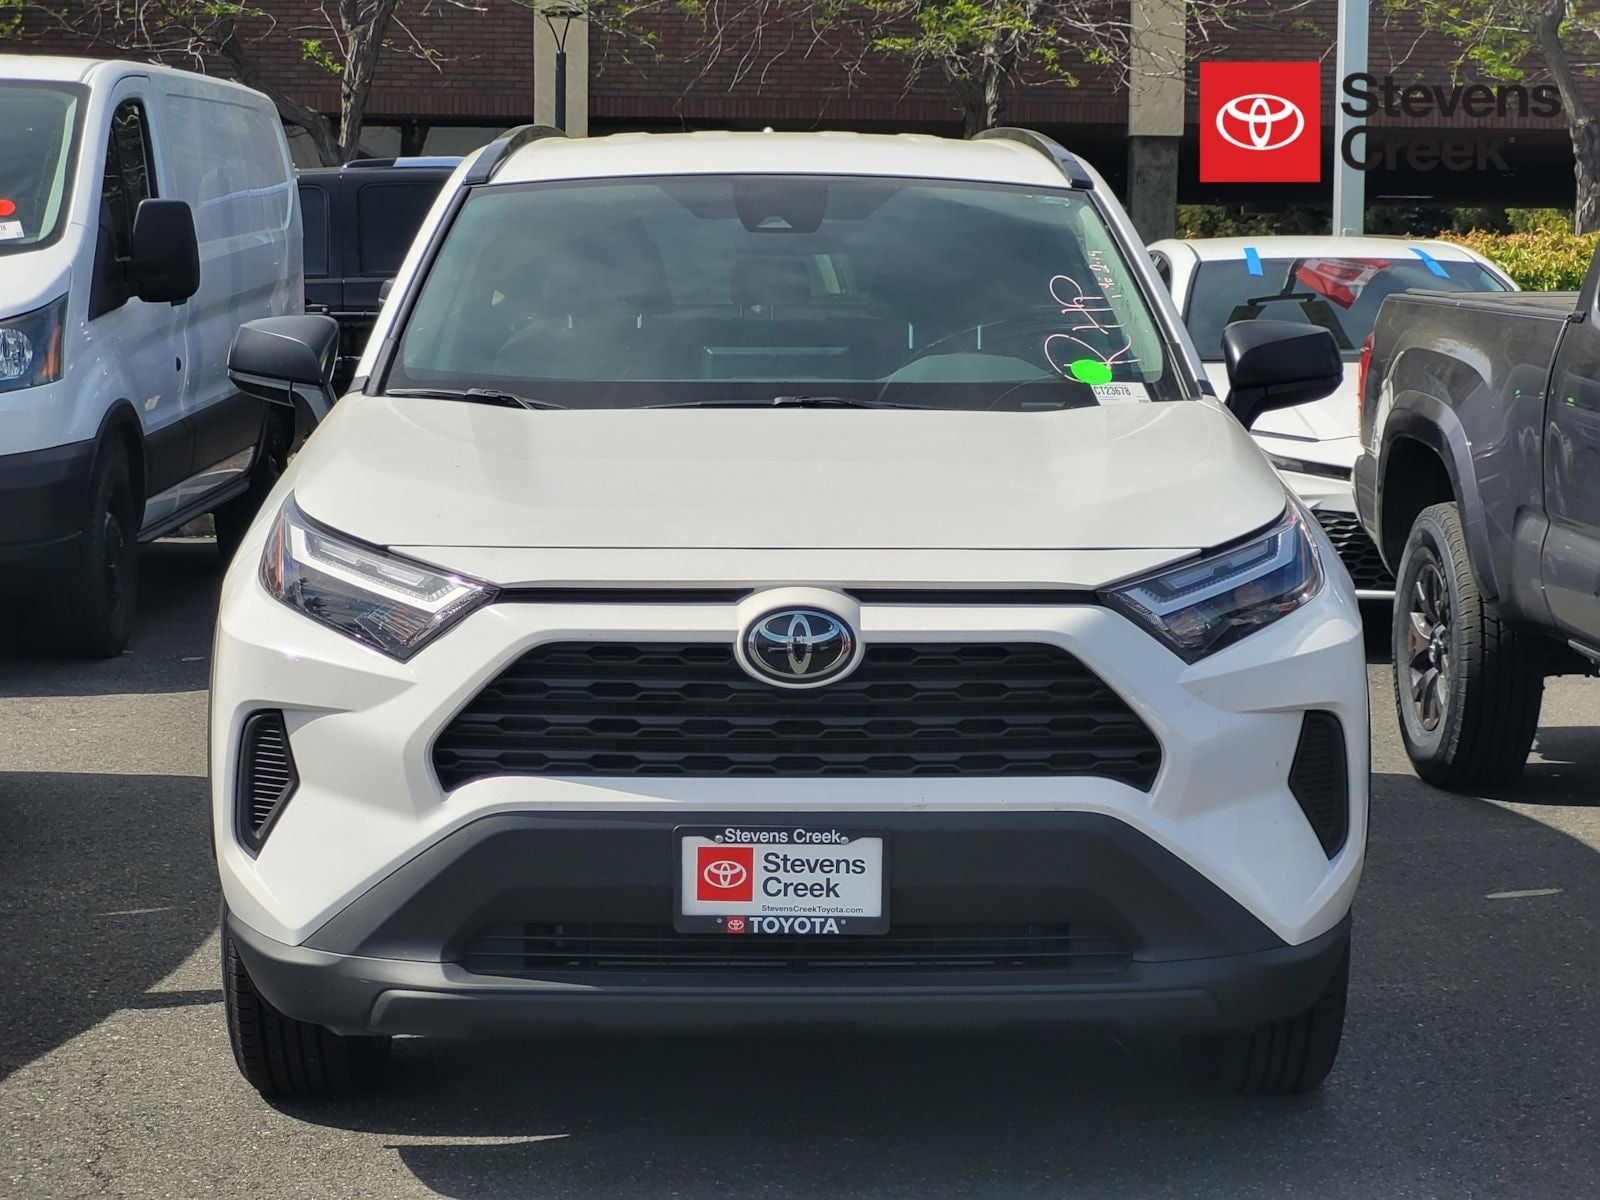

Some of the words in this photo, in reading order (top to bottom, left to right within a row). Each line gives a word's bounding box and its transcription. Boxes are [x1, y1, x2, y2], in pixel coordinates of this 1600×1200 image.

[1093, 386, 1131, 396] CT23678
[724, 828, 788, 843] Stevens
[793, 828, 841, 844] Creek
[763, 852, 866, 874] Stevens
[762, 876, 840, 898] Creek
[761, 904, 864, 914] StevensCreekToyota.com
[749, 917, 840, 935] TOYOTA
